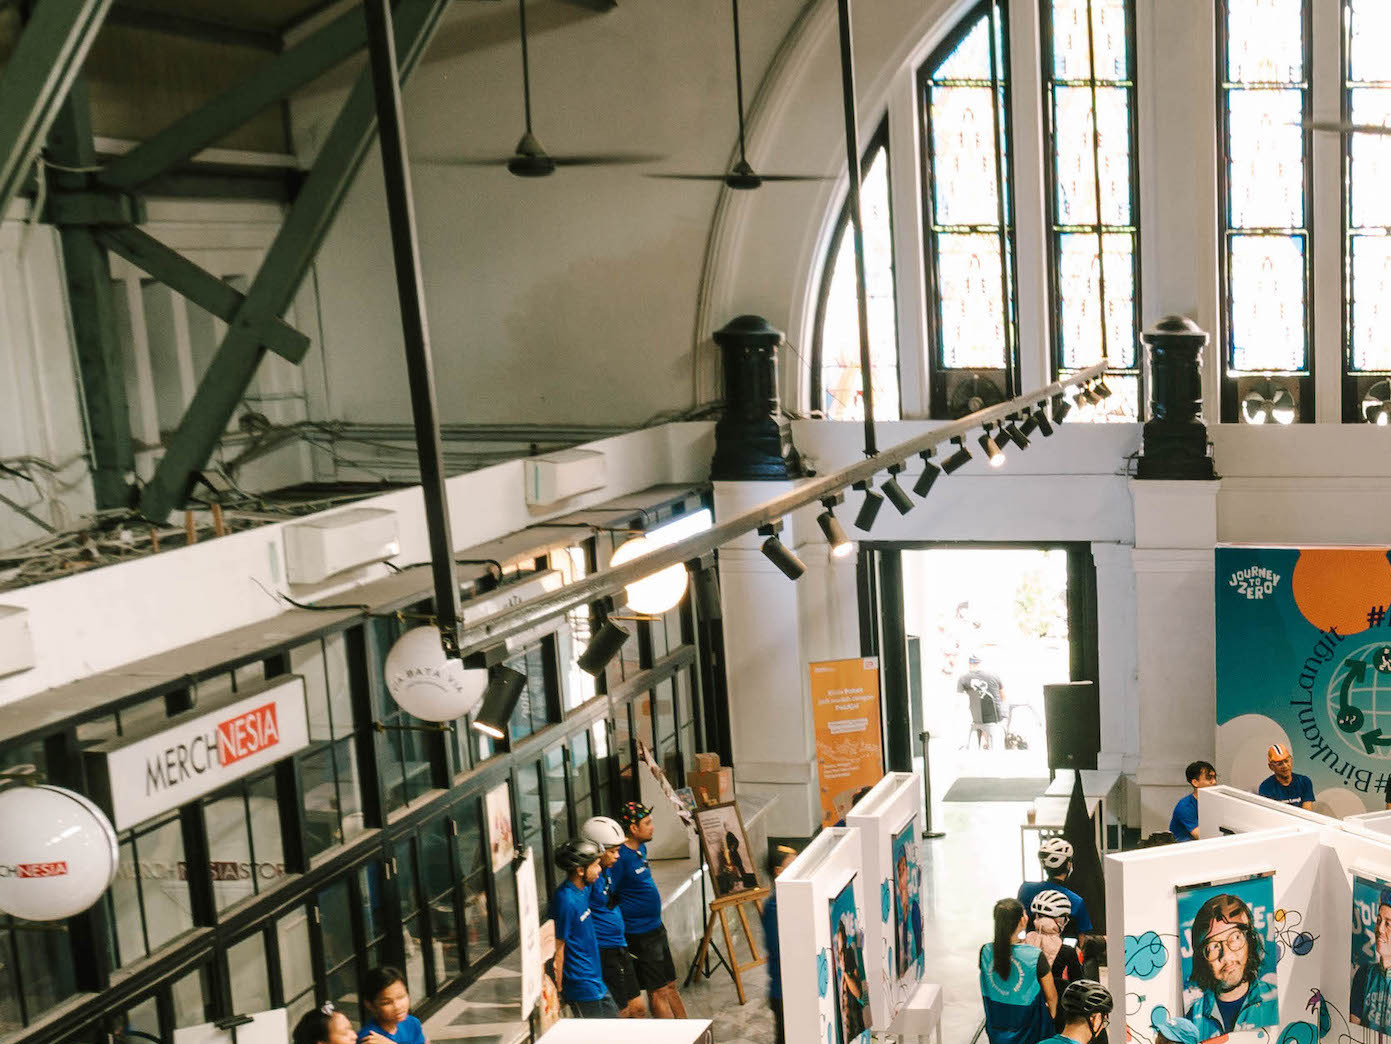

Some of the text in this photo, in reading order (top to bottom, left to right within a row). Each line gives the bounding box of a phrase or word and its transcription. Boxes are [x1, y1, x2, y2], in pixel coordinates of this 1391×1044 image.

[1229, 566, 1281, 588] JOURNEY
[1249, 578, 1261, 586] TO
[1239, 581, 1273, 599] ZERO
[145, 708, 279, 796] MERCHNESIA
